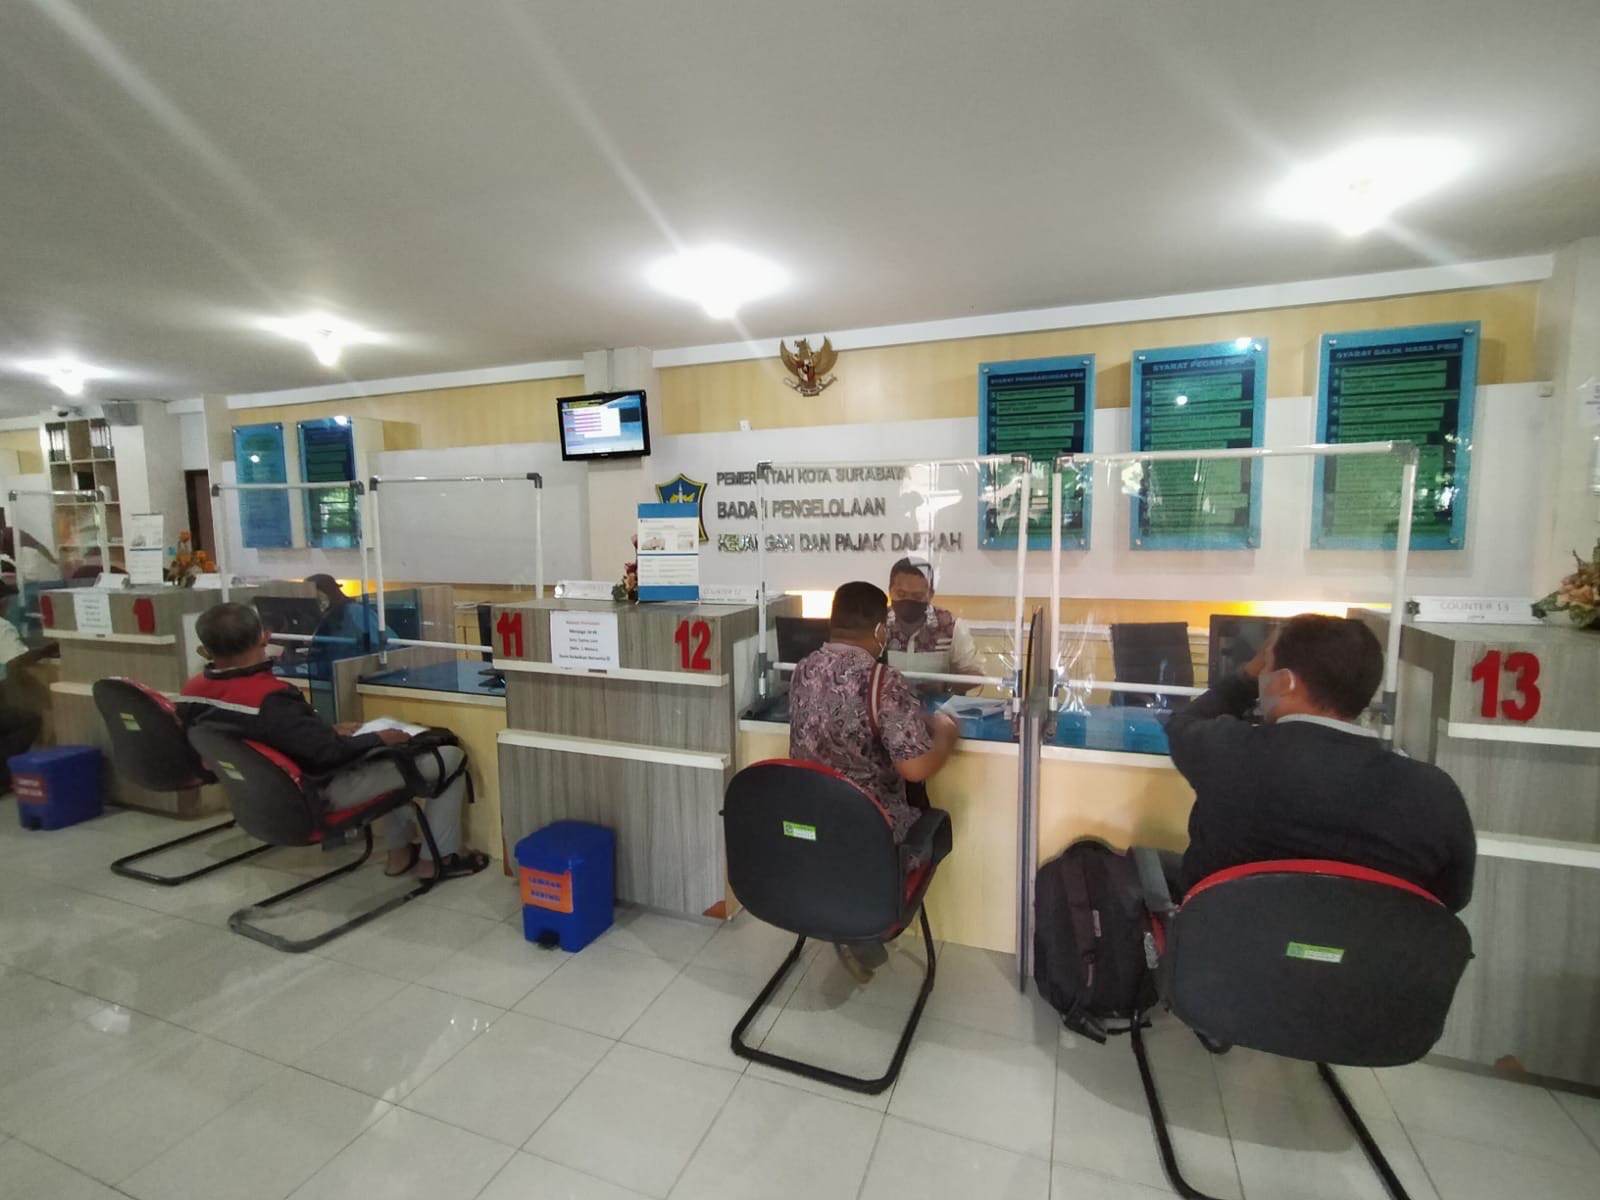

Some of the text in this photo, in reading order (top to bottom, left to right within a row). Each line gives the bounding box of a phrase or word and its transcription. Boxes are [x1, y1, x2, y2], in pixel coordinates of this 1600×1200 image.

[798, 467, 832, 484] KOTA
[772, 497, 886, 518] PENGELOLAAN
[800, 533, 831, 551] DAN
[835, 532, 885, 551] PAJAK
[496, 612, 524, 658] 11
[675, 619, 712, 671] 12
[1471, 650, 1541, 723] 13
